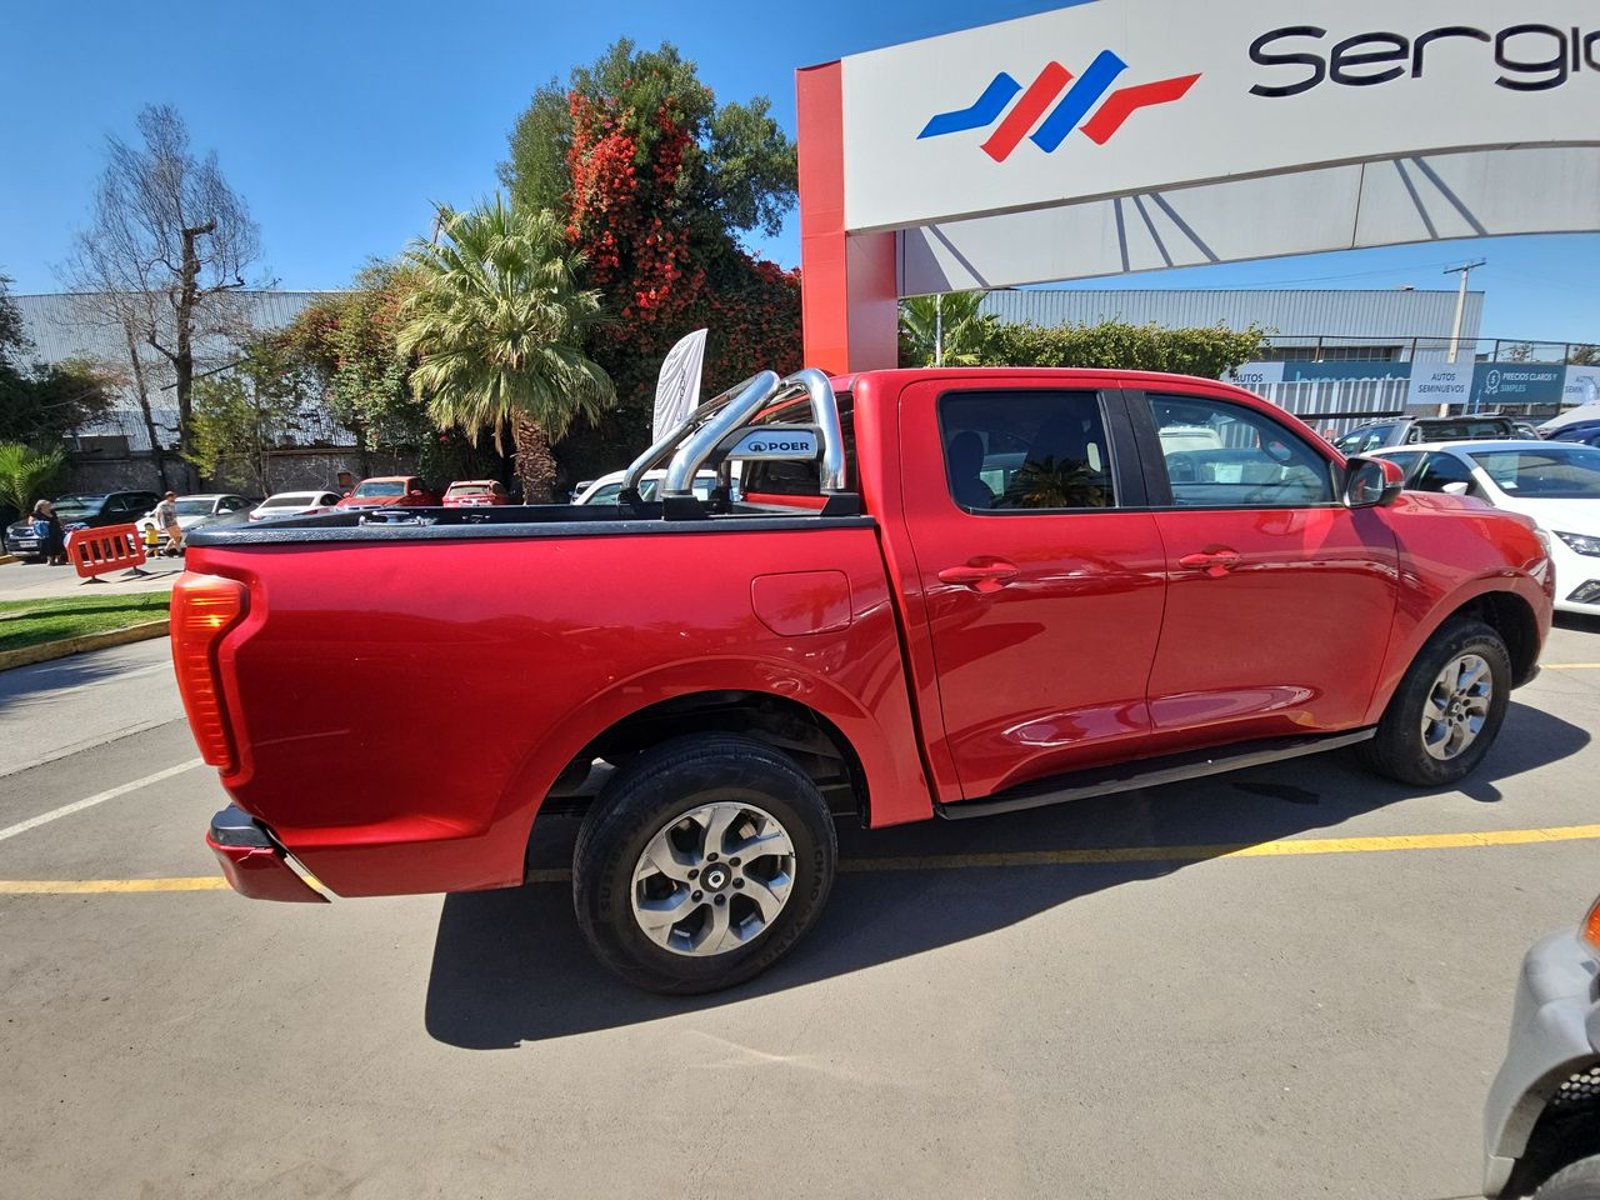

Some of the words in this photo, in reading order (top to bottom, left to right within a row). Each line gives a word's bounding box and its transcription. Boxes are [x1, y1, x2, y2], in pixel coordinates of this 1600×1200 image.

[1431, 372, 1456, 381] AUTOS
[1502, 372, 1529, 381] PRECIOS
[1418, 384, 1465, 393] SEMINUEVOS
[1500, 384, 1527, 393] SIMPLES
[768, 441, 810, 451] POER
